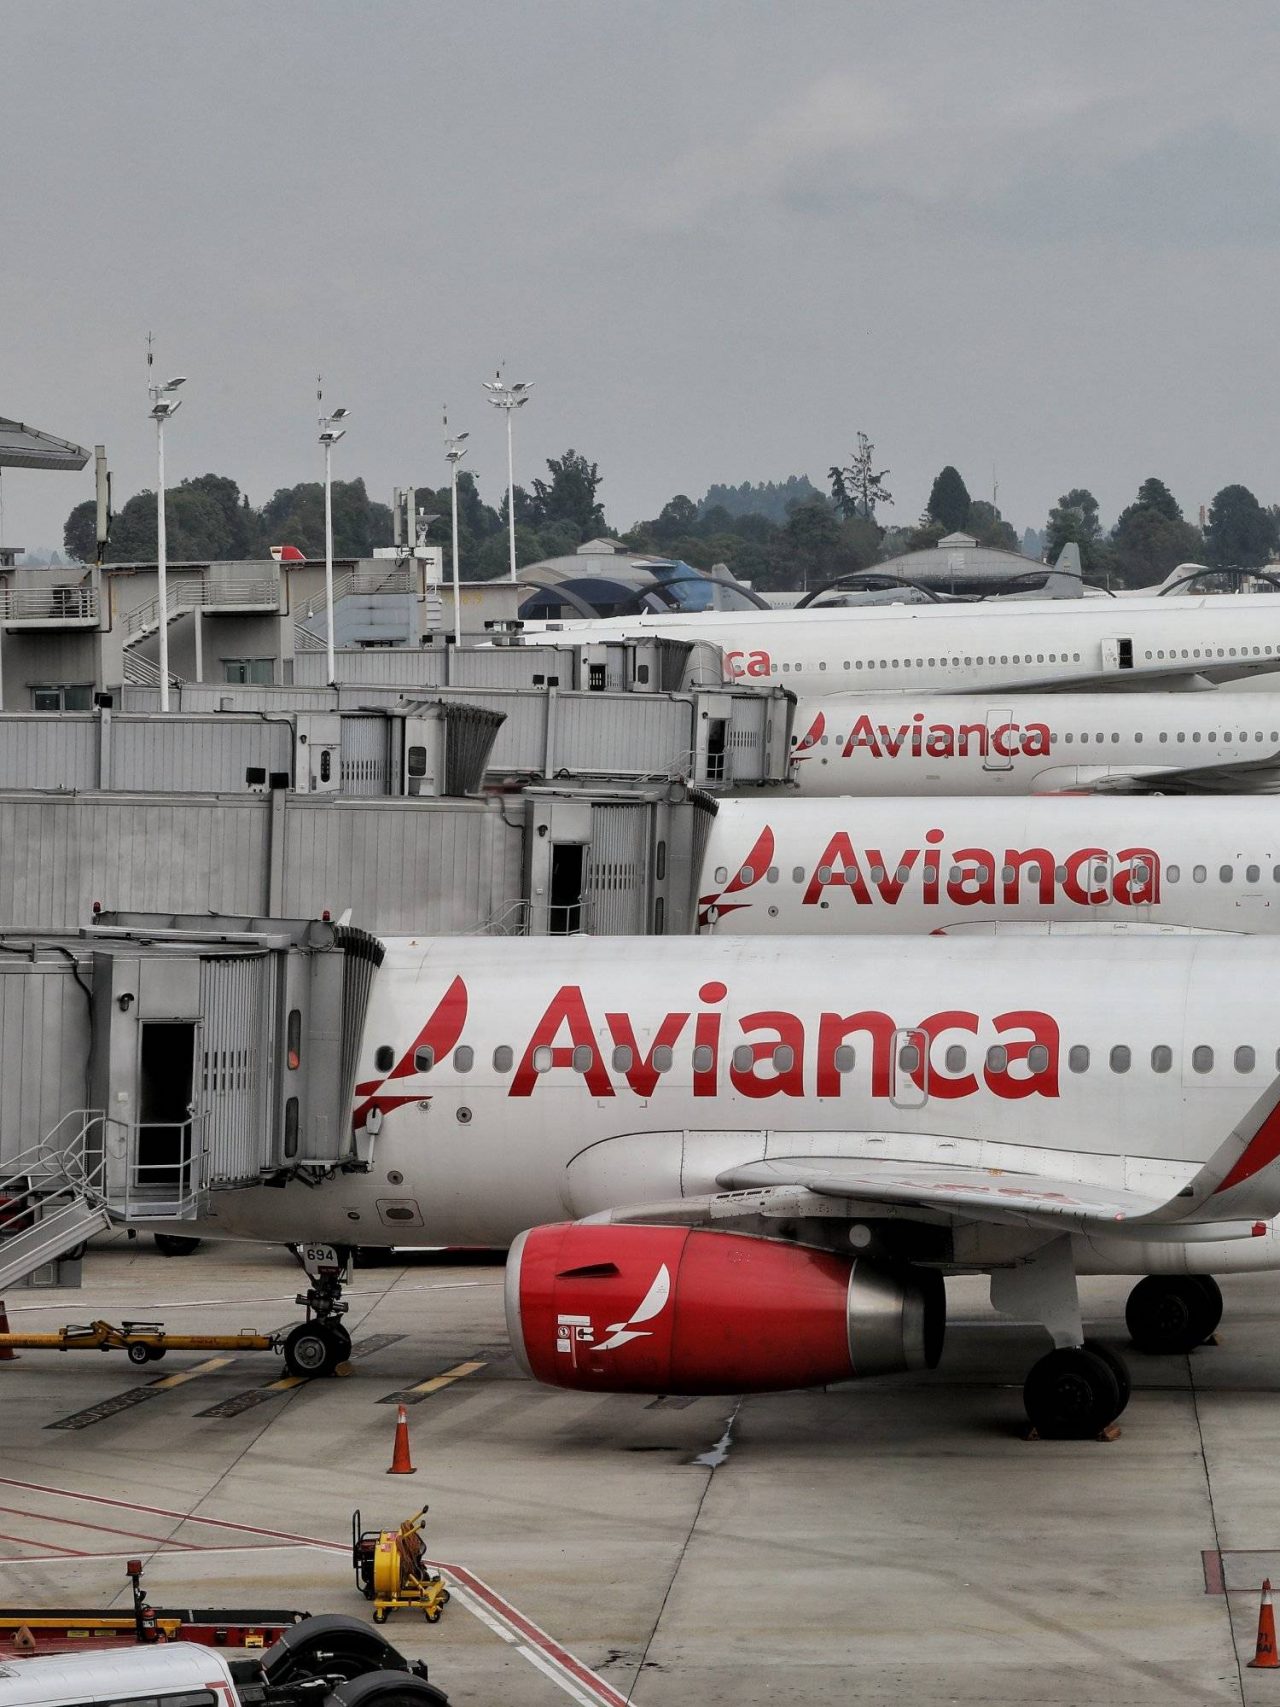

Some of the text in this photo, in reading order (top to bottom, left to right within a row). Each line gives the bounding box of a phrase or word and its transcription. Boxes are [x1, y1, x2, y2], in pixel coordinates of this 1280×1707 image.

[842, 713, 1051, 758] Avianca
[802, 829, 1161, 906] Avianca
[508, 981, 1060, 1099] Avianca
[307, 1248, 334, 1261] 694
